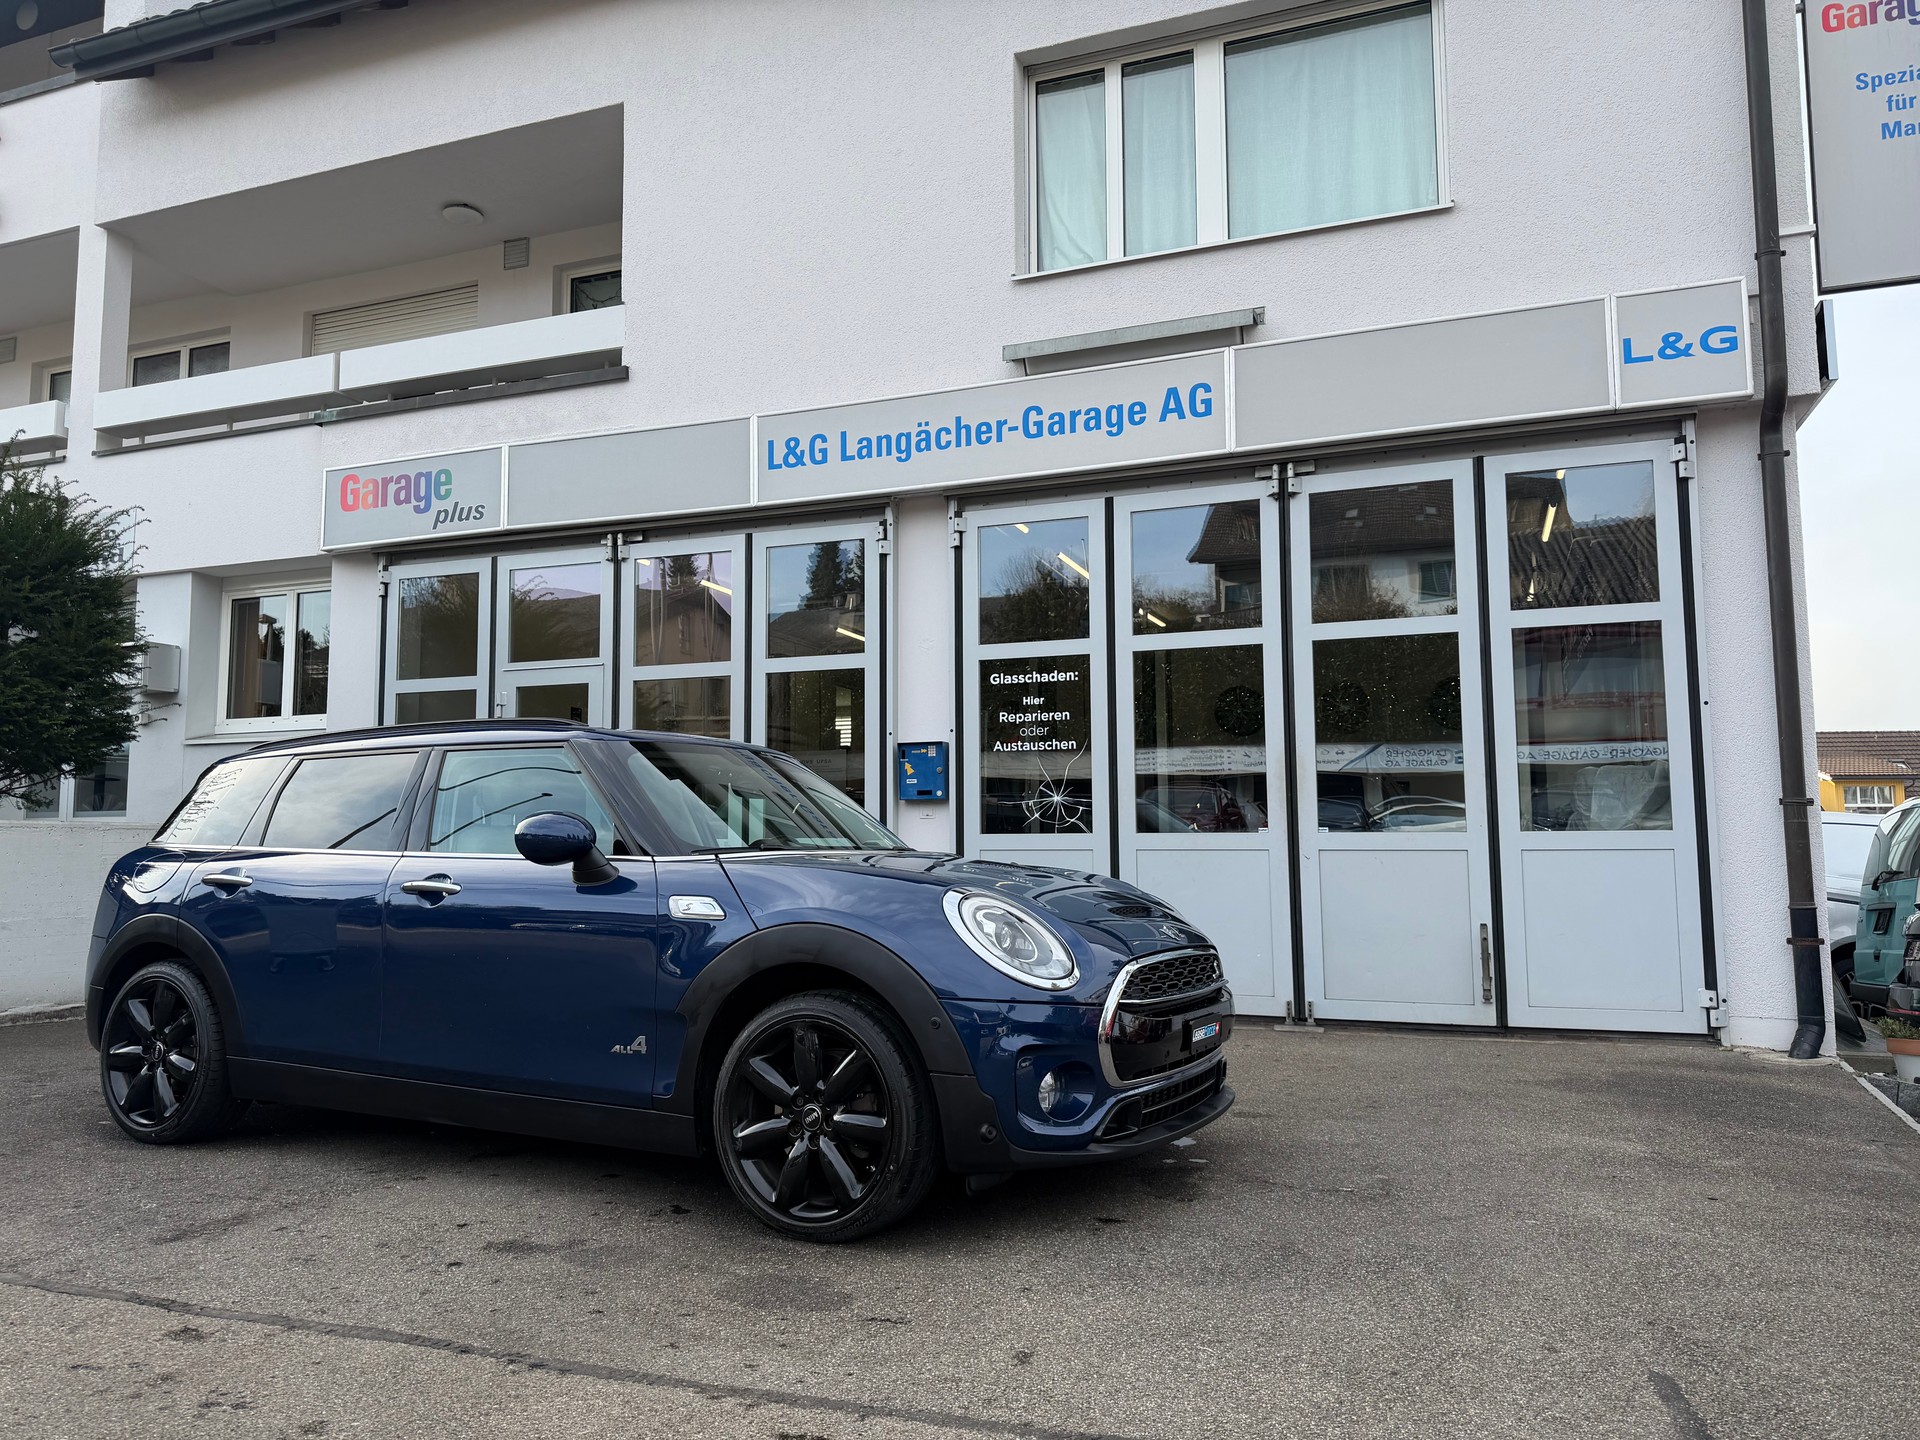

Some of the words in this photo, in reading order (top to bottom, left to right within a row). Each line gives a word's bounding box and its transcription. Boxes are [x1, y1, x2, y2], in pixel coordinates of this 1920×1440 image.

[1855, 64, 1920, 93] Spezi
[1886, 94, 1917, 112] für
[1881, 120, 1920, 140] Ma
[1622, 325, 1739, 365] L&G
[767, 433, 829, 470] L&G
[840, 400, 1147, 463] Langächer-Garage
[1158, 382, 1213, 423] AG
[340, 468, 452, 514] Garage
[432, 501, 486, 530] plus
[989, 670, 1079, 685] Glasschaden:
[1022, 696, 1045, 705] Hier
[999, 711, 1070, 725] Reparieren
[1019, 725, 1050, 737] oder
[993, 738, 1077, 752] Austauschen
[610, 1035, 648, 1054] ALL4
